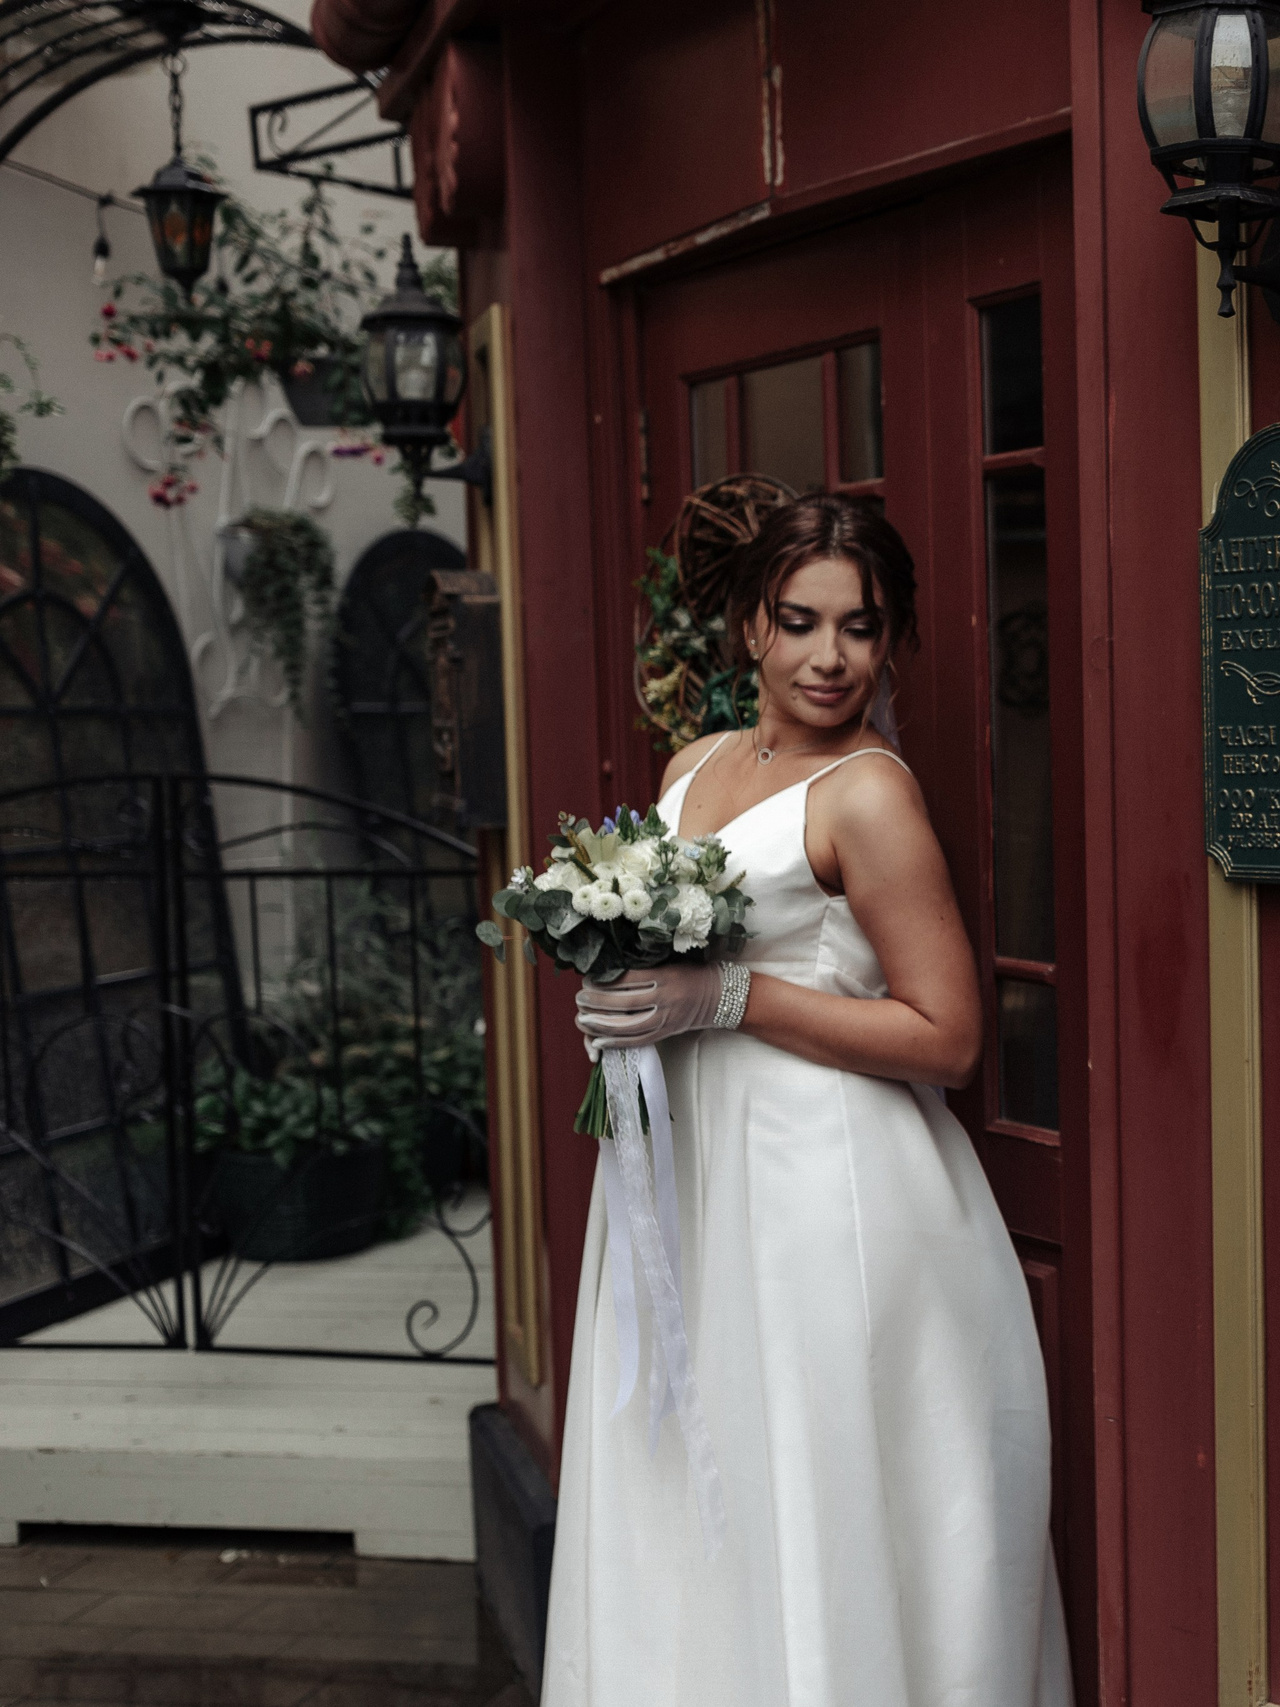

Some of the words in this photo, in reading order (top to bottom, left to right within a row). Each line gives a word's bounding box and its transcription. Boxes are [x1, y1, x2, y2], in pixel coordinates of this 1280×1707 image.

[1218, 725, 1277, 746] ЧАСЫ
[1222, 754, 1269, 774] ПН-ВС
[1218, 788, 1256, 809] ООО
